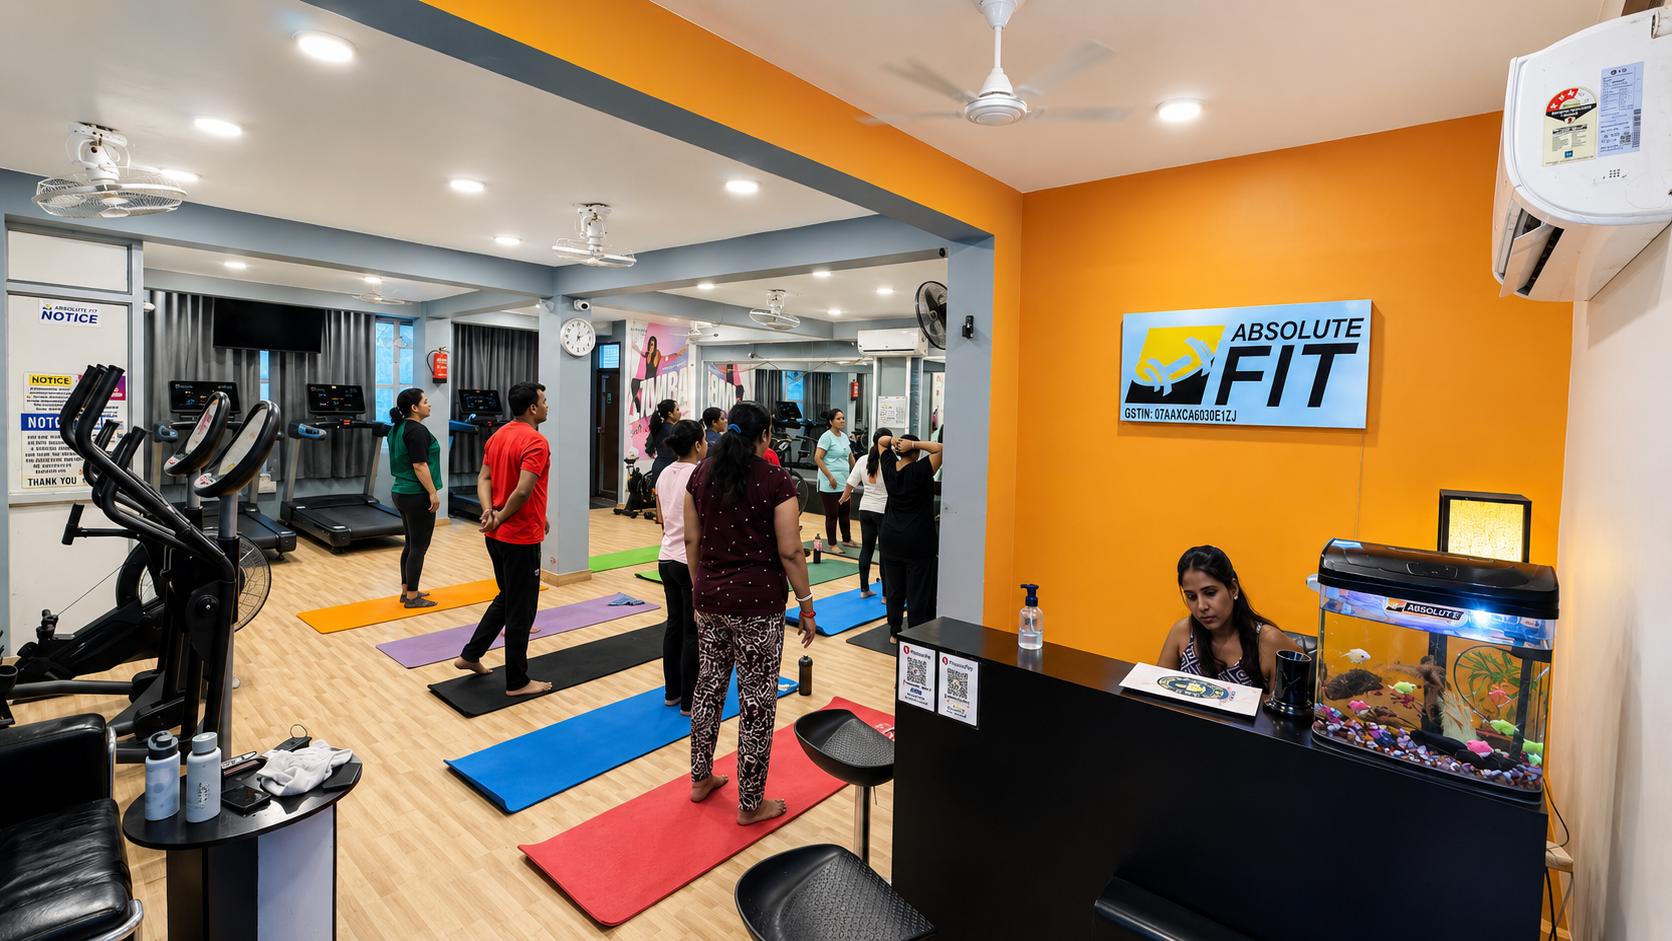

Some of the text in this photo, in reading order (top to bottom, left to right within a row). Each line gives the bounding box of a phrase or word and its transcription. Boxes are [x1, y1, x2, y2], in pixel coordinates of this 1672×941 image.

[55, 305, 87, 313] ABSOLUTE
[41, 310, 98, 324] NOTICE
[1230, 317, 1365, 342] ABSOLUTE
[31, 375, 70, 385] NOTICE
[1214, 342, 1360, 408] FIT
[1124, 407, 1153, 420] GSTIN:
[28, 476, 77, 487] THANK YOU
[1407, 604, 1459, 619] ABSOLUTE
